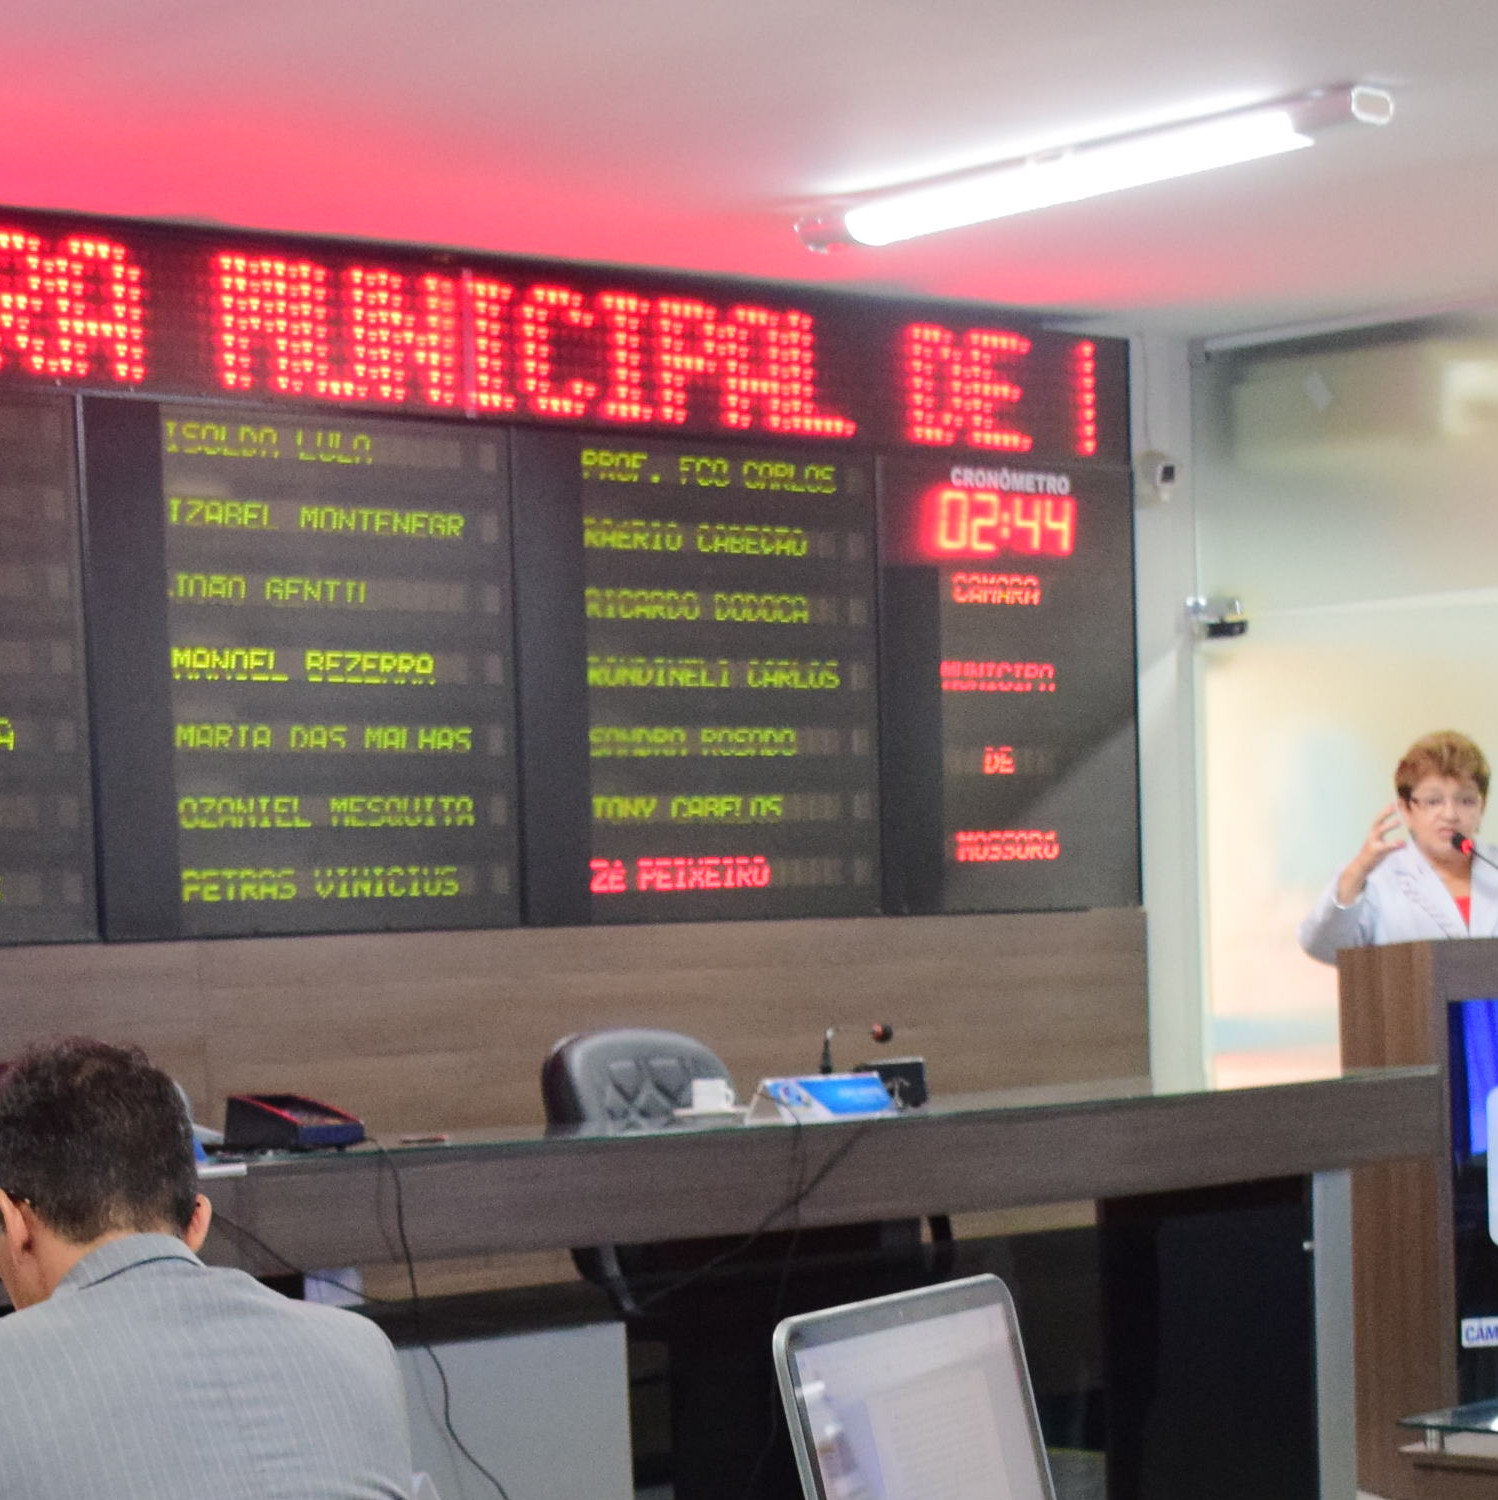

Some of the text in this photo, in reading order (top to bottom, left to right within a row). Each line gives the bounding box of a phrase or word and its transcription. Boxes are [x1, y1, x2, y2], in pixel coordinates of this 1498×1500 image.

[214, 250, 859, 438] MUNICIPAL
[903, 324, 1033, 453] DE
[935, 486, 1076, 556] 02:44
[175, 724, 273, 751] MARIA
[290, 725, 348, 752] DAS
